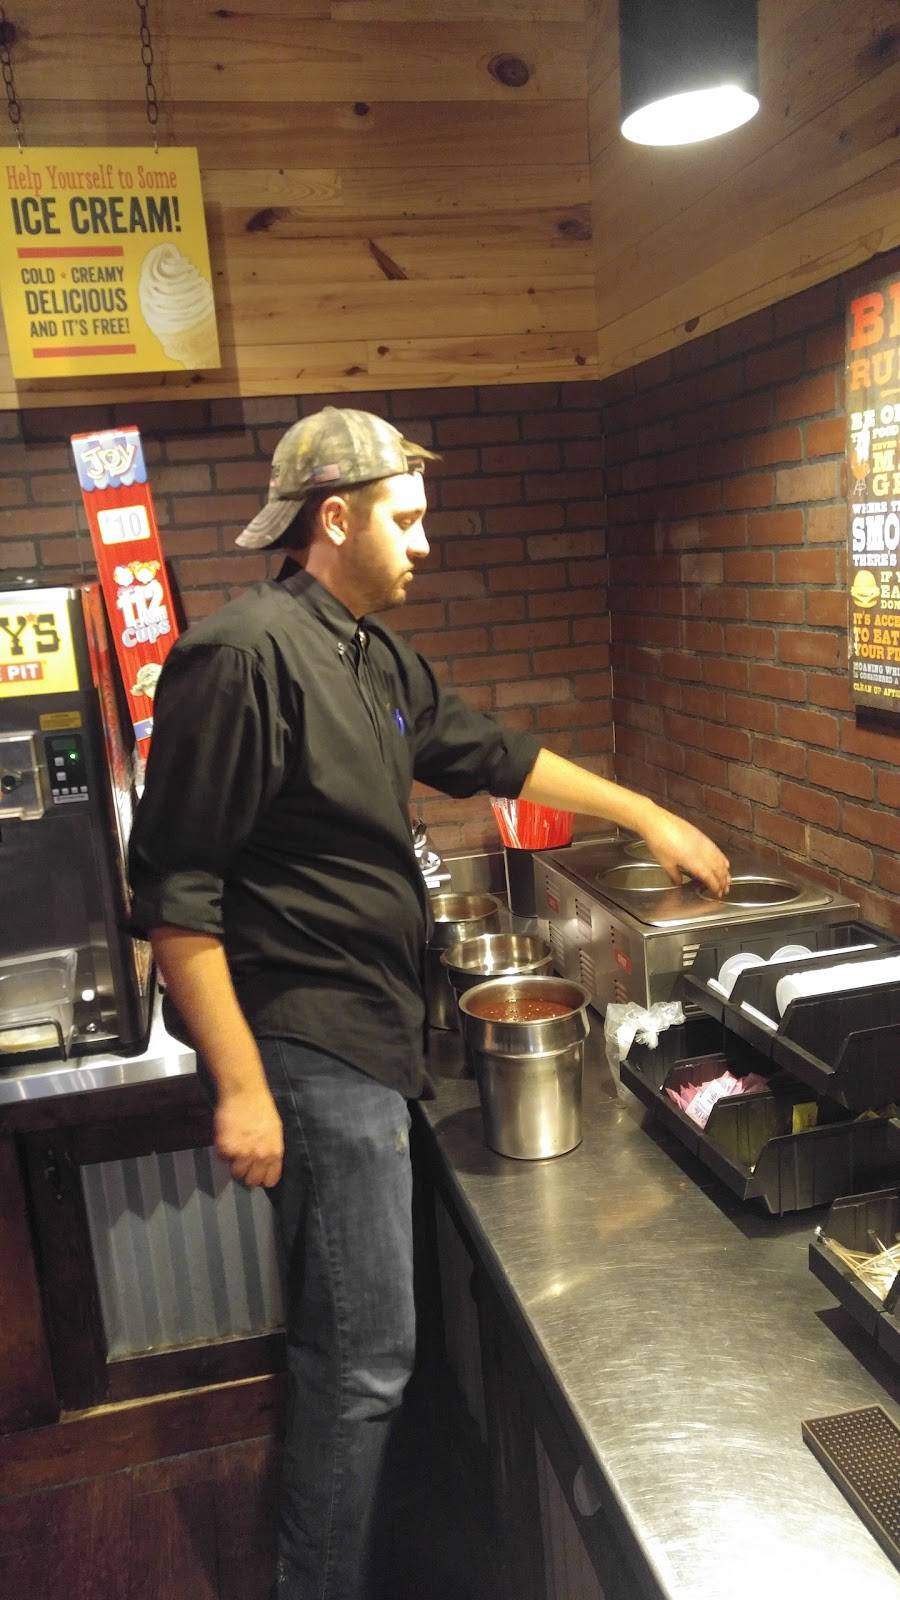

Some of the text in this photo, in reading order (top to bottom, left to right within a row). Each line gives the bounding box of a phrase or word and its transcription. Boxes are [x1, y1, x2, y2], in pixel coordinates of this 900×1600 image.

[6, 163, 177, 196] Help Yourself to Some
[10, 196, 182, 235] ICE CREAM!
[21, 266, 124, 285] COLD CREAMY
[25, 288, 128, 315] DELICIOUS
[30, 318, 130, 338] AND IT'S FREE!
[853, 611, 871, 626] IT'S
[853, 626, 900, 646] TO EAT
[853, 642, 885, 660] YOUR
[8, 664, 39, 681] PIT
